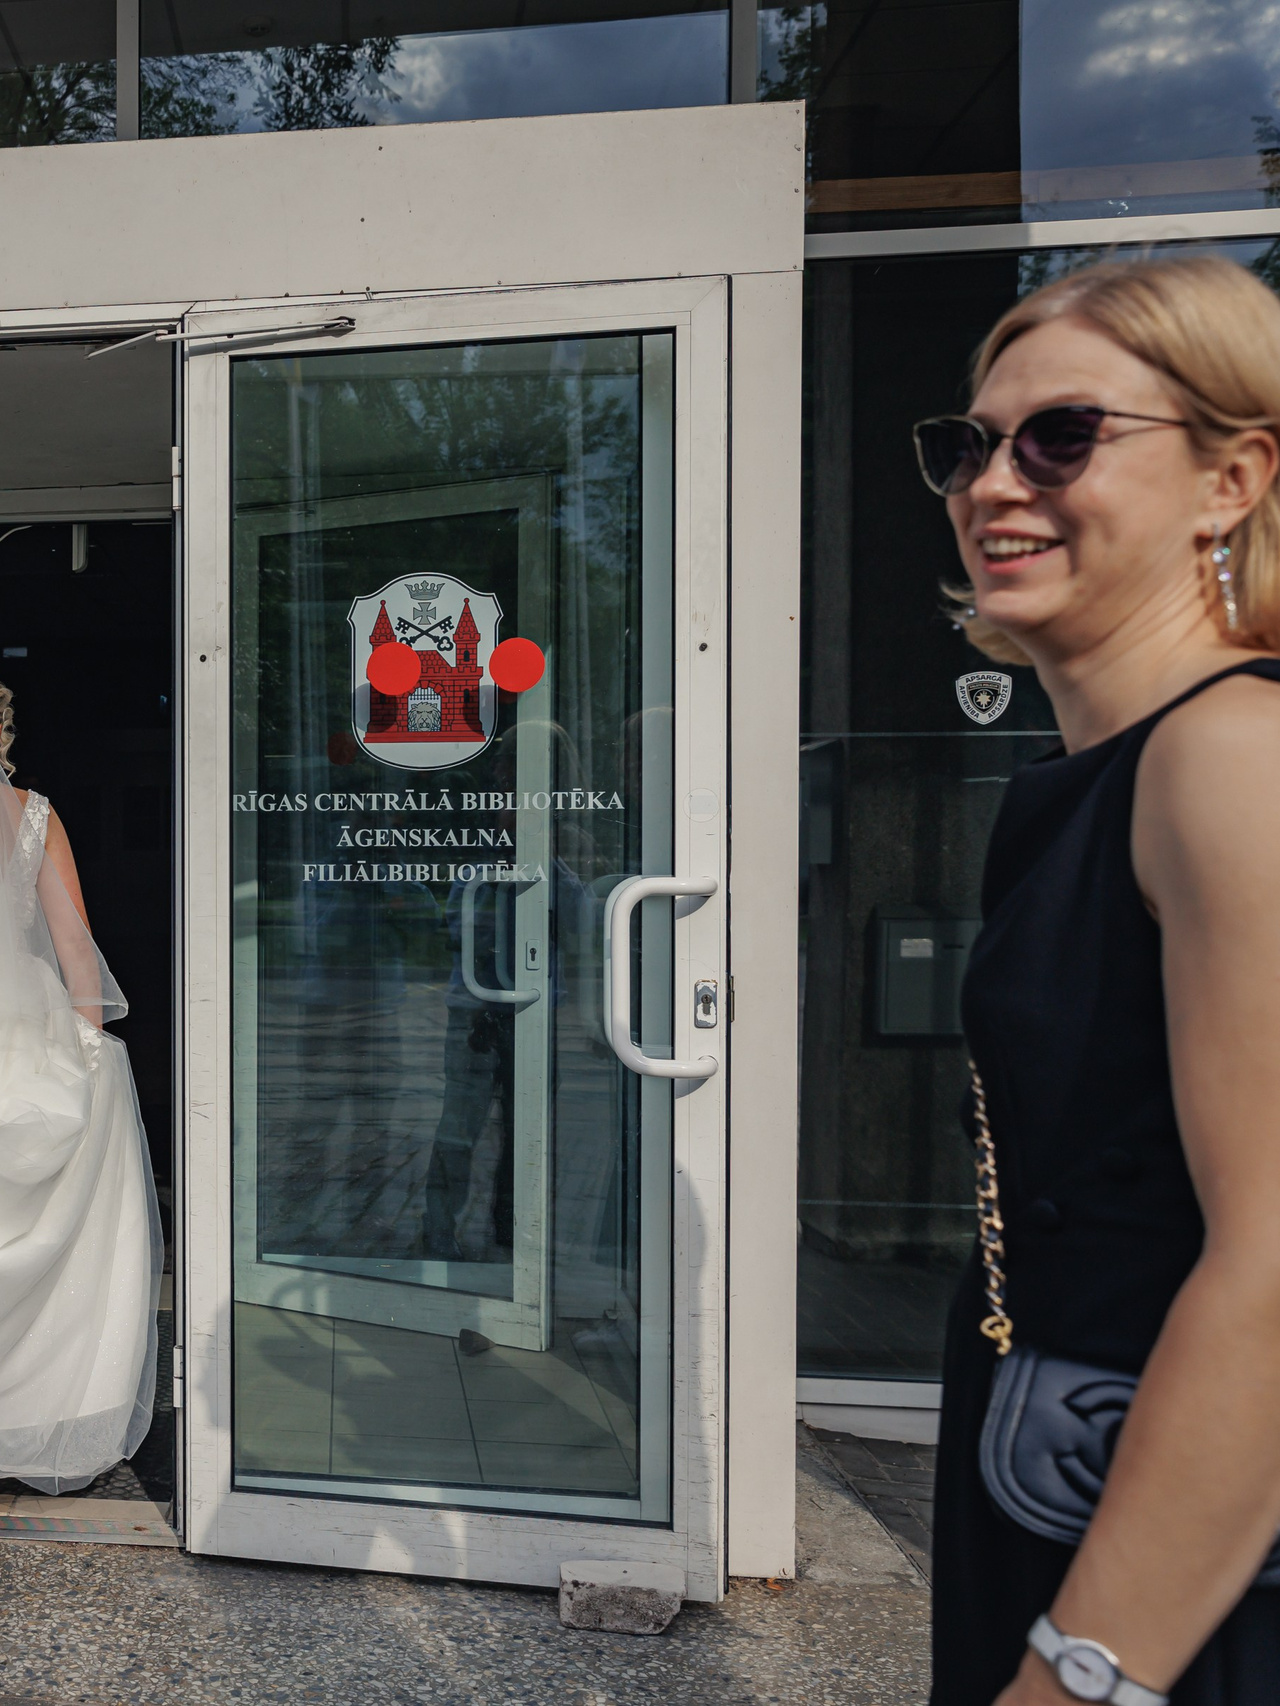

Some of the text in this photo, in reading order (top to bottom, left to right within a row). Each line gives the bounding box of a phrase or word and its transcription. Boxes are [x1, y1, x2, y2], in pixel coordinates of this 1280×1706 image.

[233, 788, 625, 812] RĪGAS CENTRĀLĀ BIBLIOTĒKA
[336, 825, 514, 847] ĀGENSKALNA
[302, 860, 549, 882] FILIĀLBIBLIOTĒKA
